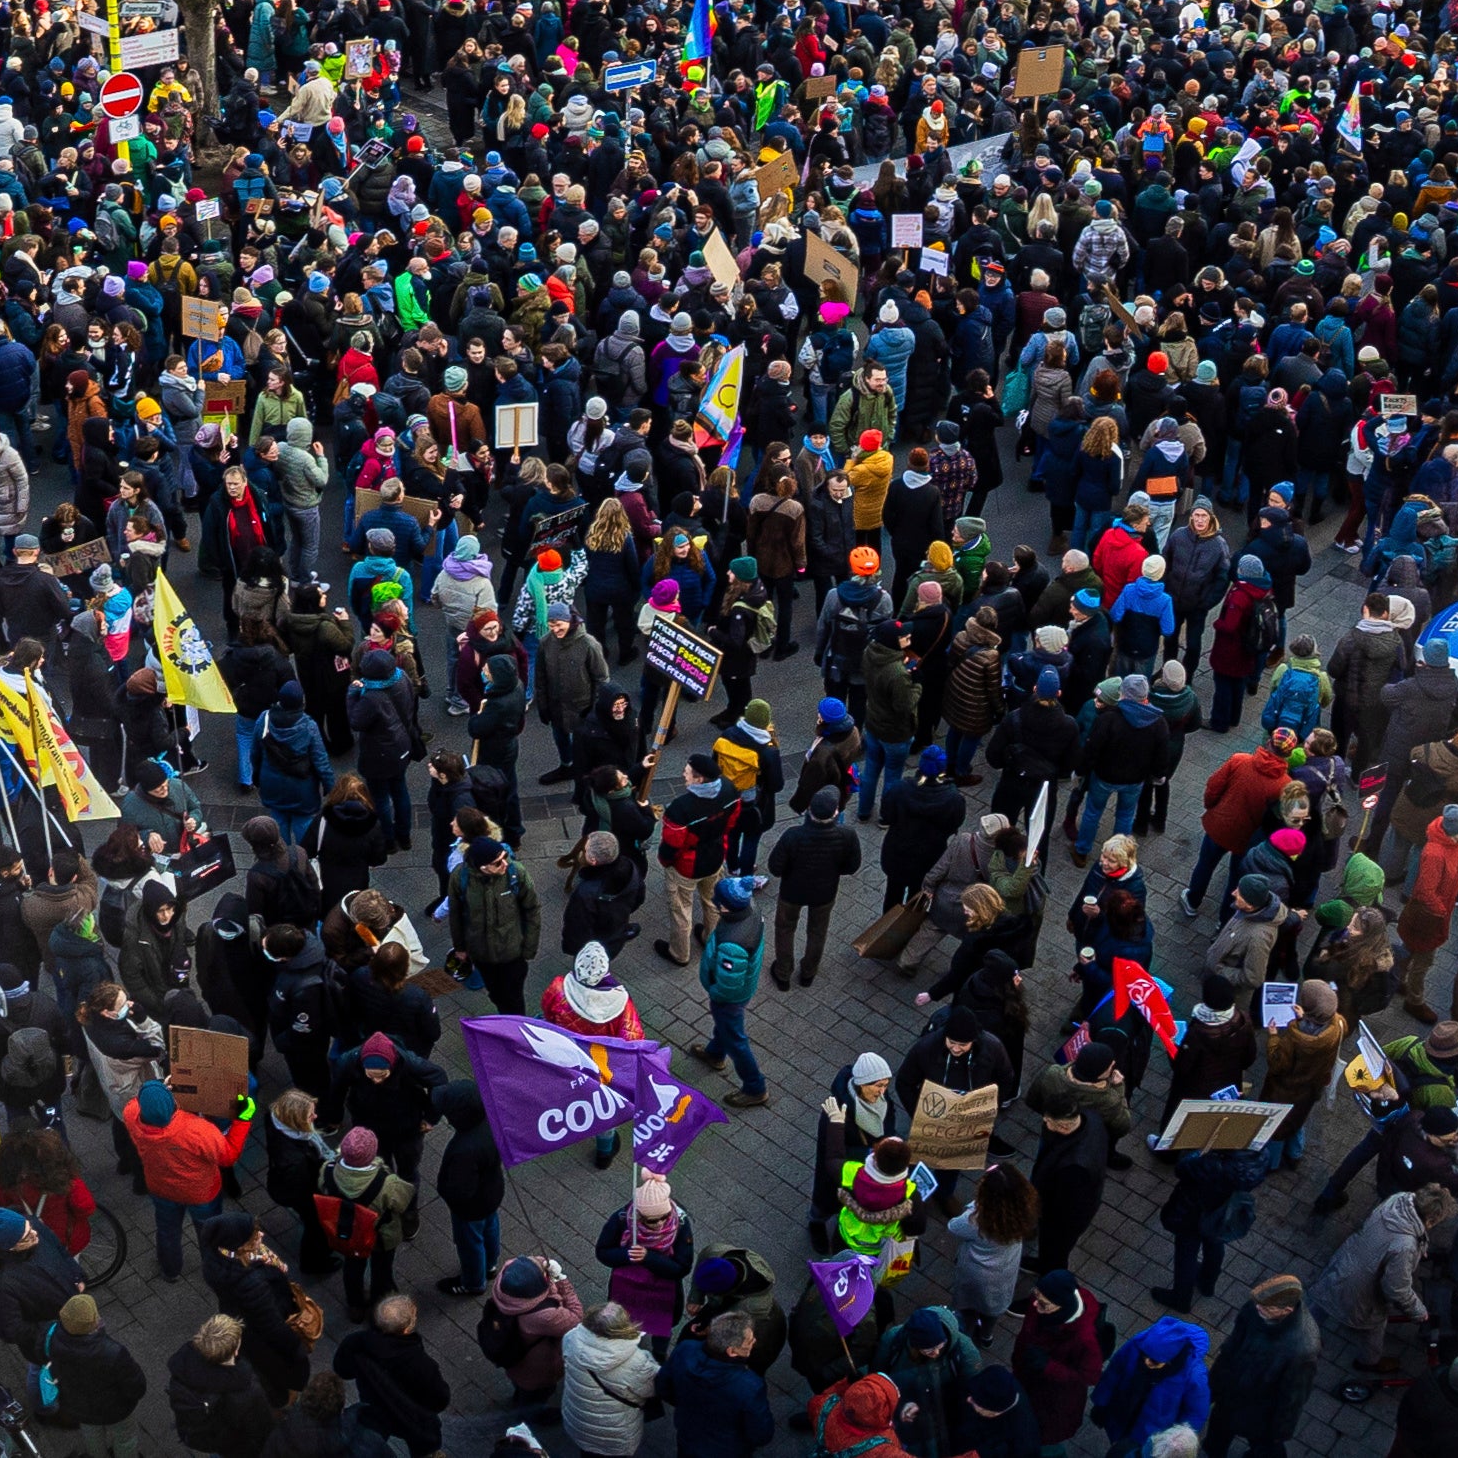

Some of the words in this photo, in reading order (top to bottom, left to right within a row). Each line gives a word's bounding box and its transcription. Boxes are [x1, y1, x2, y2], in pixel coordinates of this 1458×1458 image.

[675, 656, 709, 684] Faschos
[678, 646, 712, 674] Faschos
[922, 1123, 976, 1139] GEGEN
